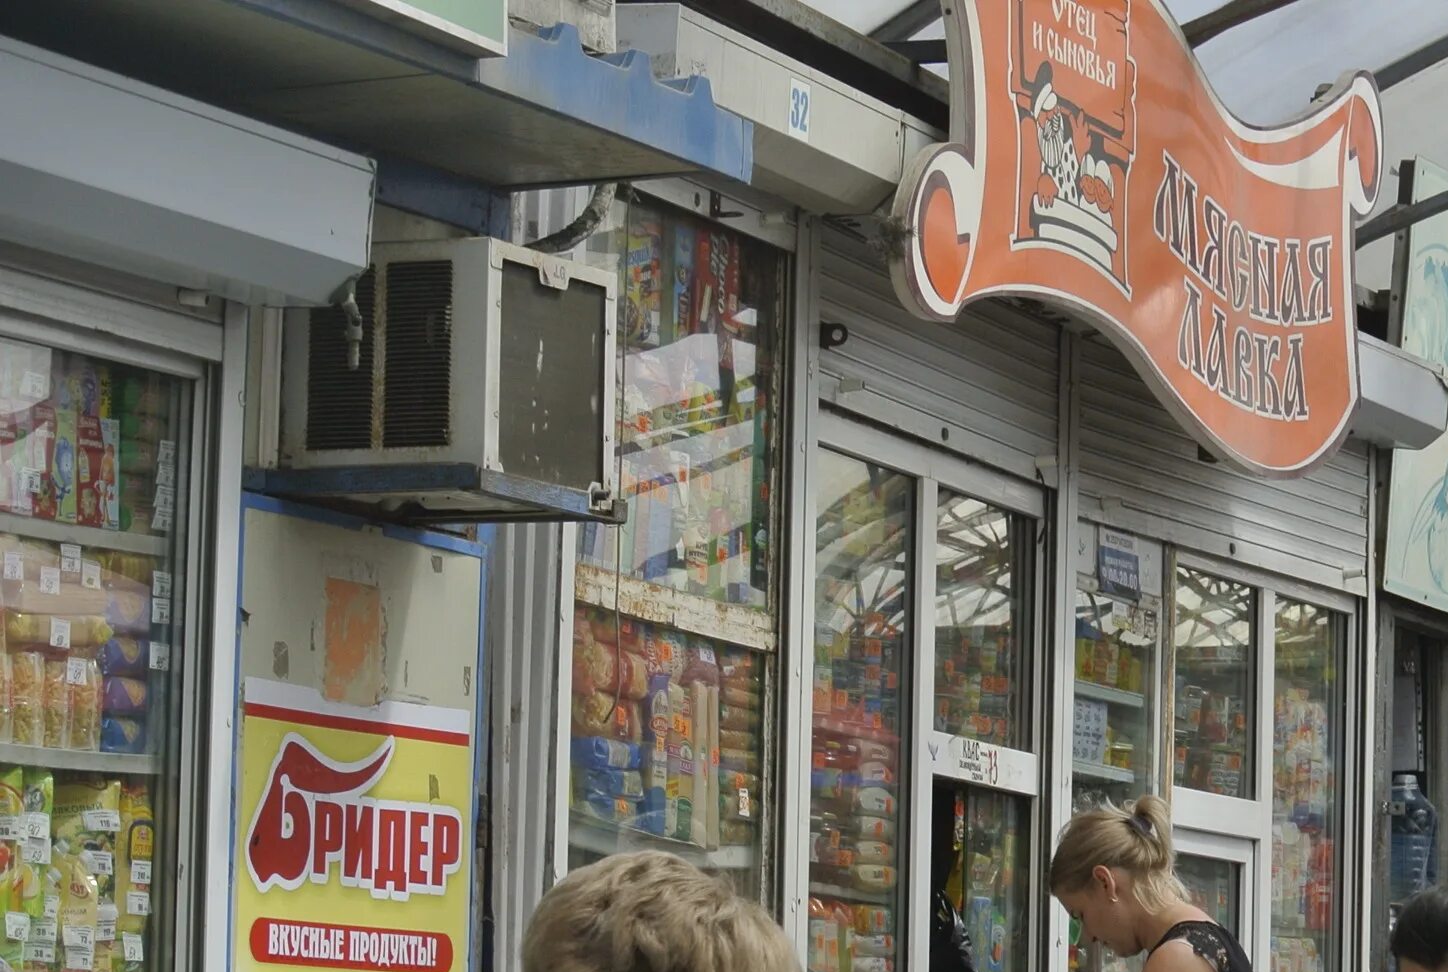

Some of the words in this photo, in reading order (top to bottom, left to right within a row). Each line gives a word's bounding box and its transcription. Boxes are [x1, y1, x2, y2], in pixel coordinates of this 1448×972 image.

[791, 87, 809, 132] 32
[1033, 21, 1043, 52] И
[1047, 28, 1116, 91] СЫНОВЬЯ
[1154, 149, 1333, 328] МЯСНАЯ
[1178, 275, 1309, 422] ЛАВКА
[245, 733, 464, 902] БРИДЕР
[268, 923, 344, 960] ВКУСНЫЕ
[349, 931, 437, 967] ПРОДУКТЫ!
